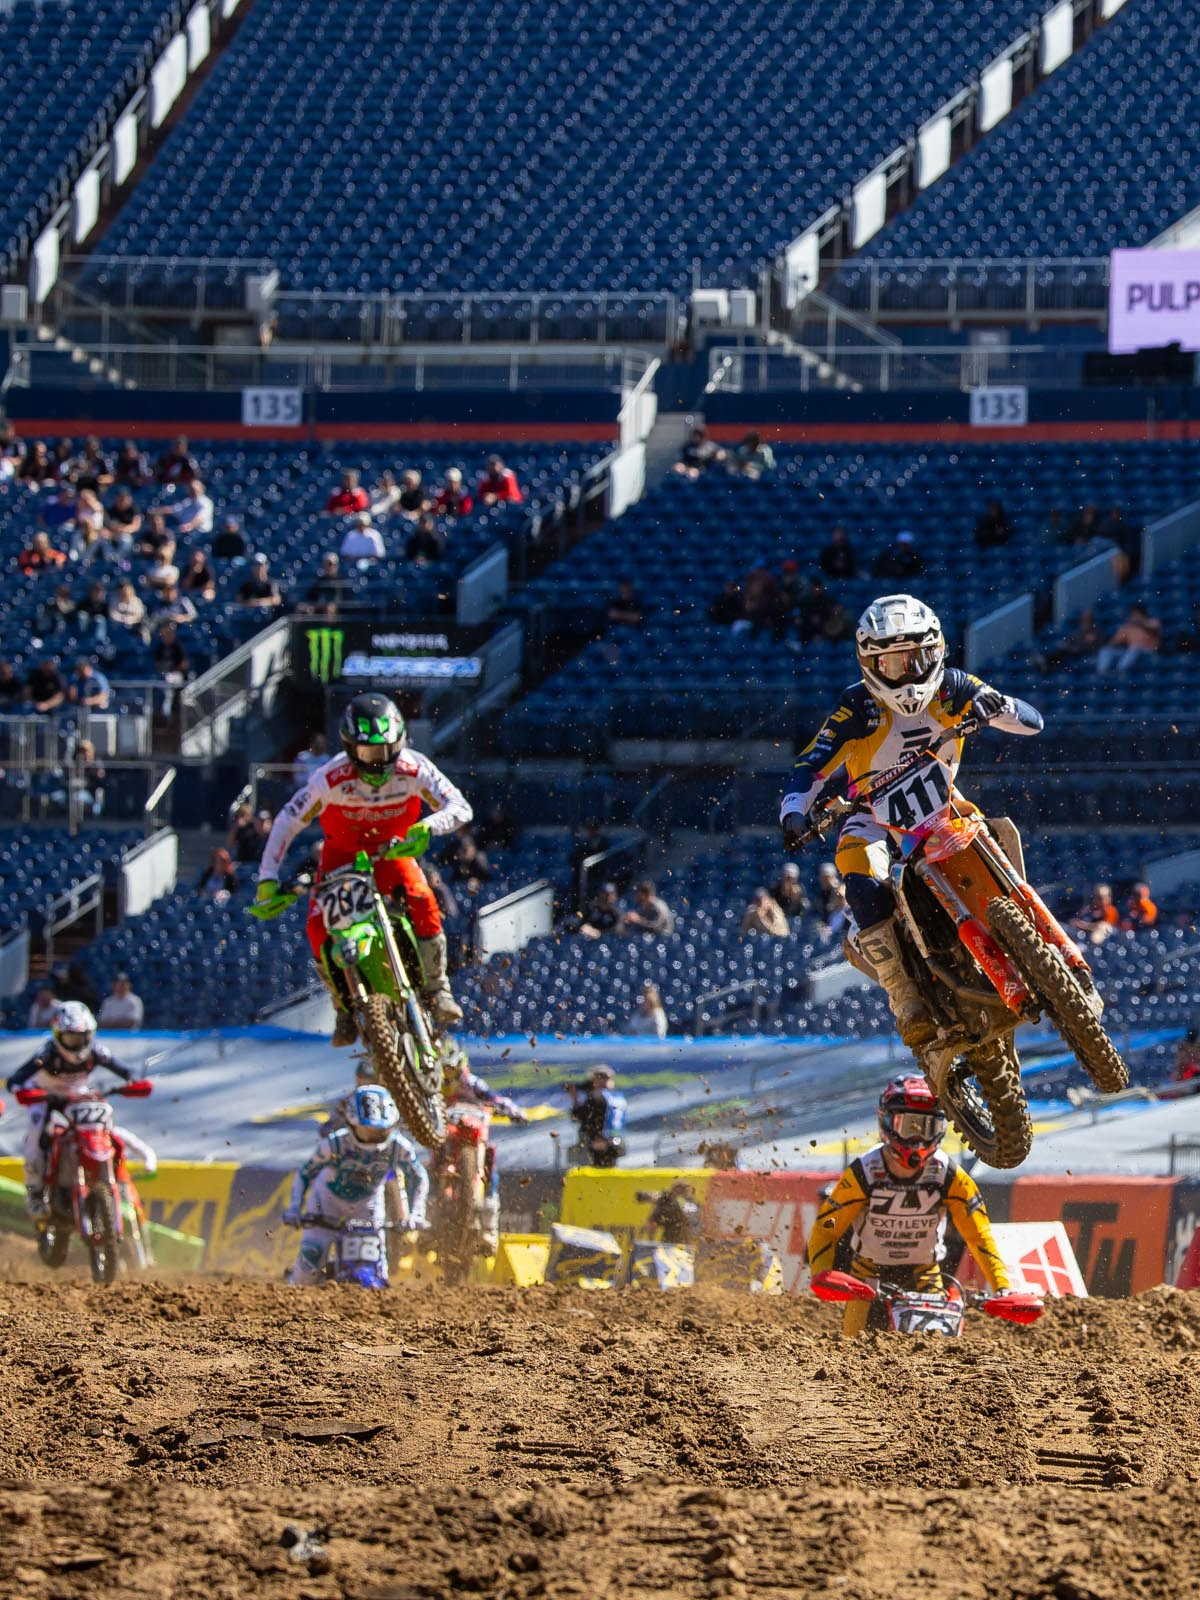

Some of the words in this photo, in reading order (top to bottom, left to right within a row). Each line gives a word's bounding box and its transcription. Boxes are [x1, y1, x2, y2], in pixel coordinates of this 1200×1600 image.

[252, 394, 298, 420] 135
[979, 392, 1022, 420] 135
[888, 762, 950, 830] 411
[70, 1106, 107, 1124] 122
[869, 1188, 941, 1215] FLY
[869, 1217, 896, 1230] EXT
